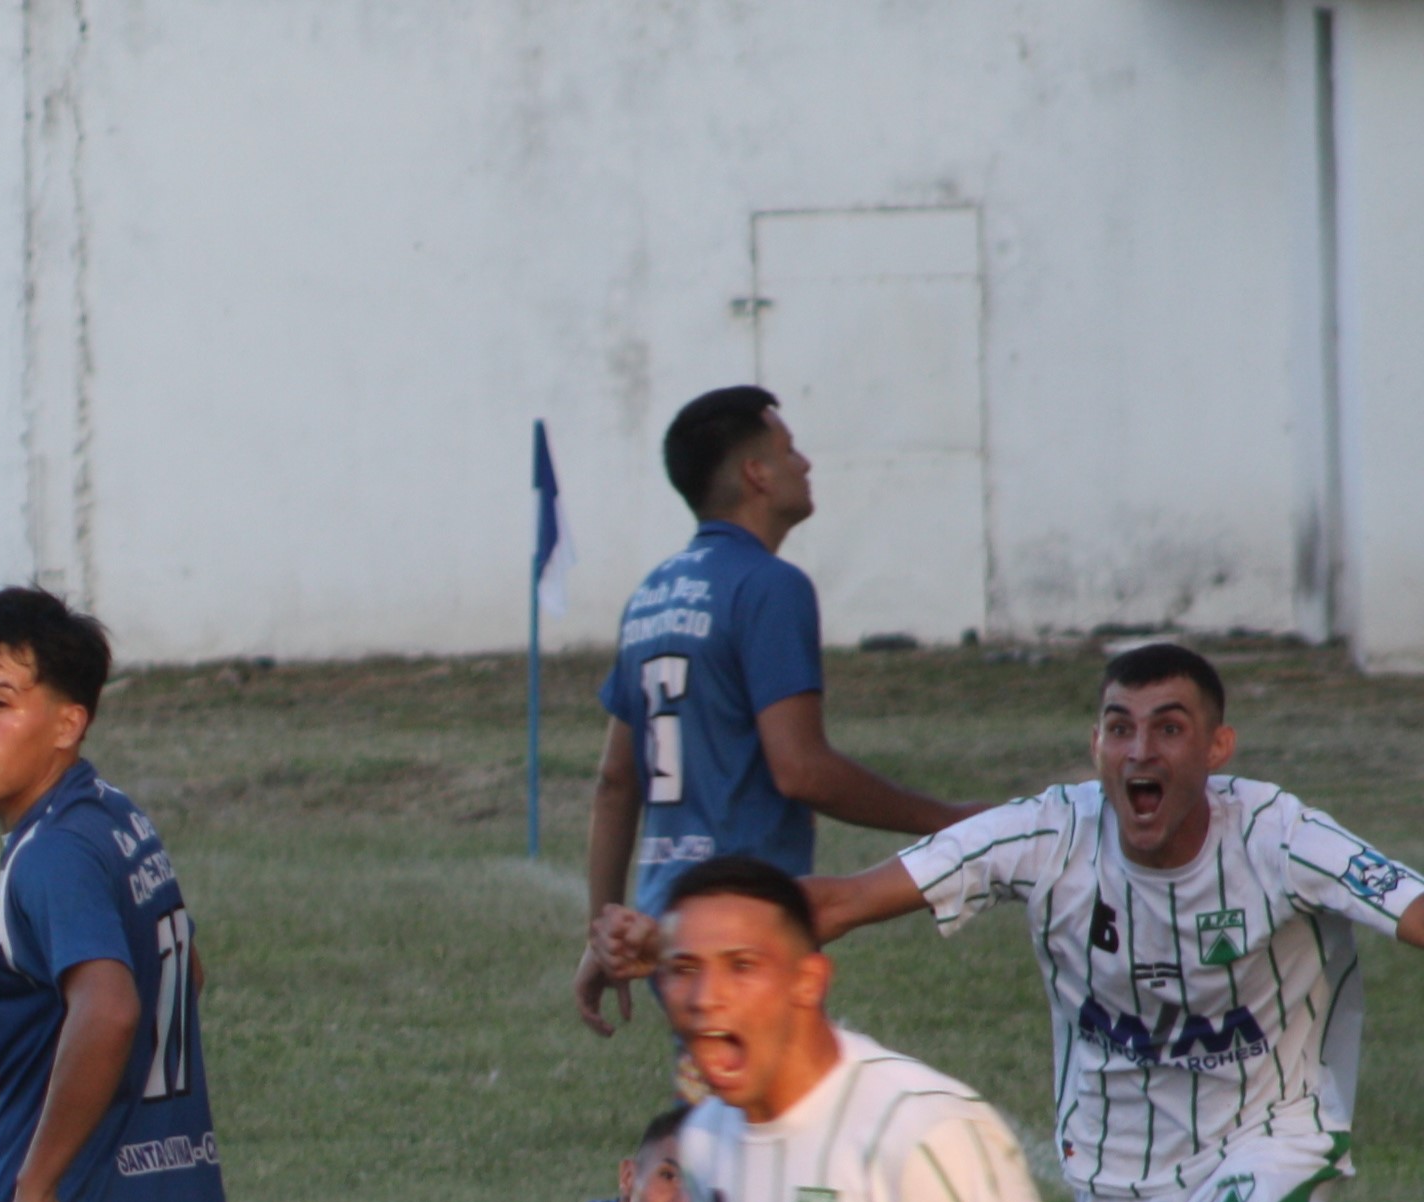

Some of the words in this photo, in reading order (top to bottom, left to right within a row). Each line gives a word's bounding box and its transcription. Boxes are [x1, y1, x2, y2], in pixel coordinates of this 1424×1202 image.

[640, 655, 691, 805] 6
[1090, 899, 1120, 954] 6
[142, 904, 192, 1103] 11
[1156, 1038, 1270, 1073] ARCHESI
